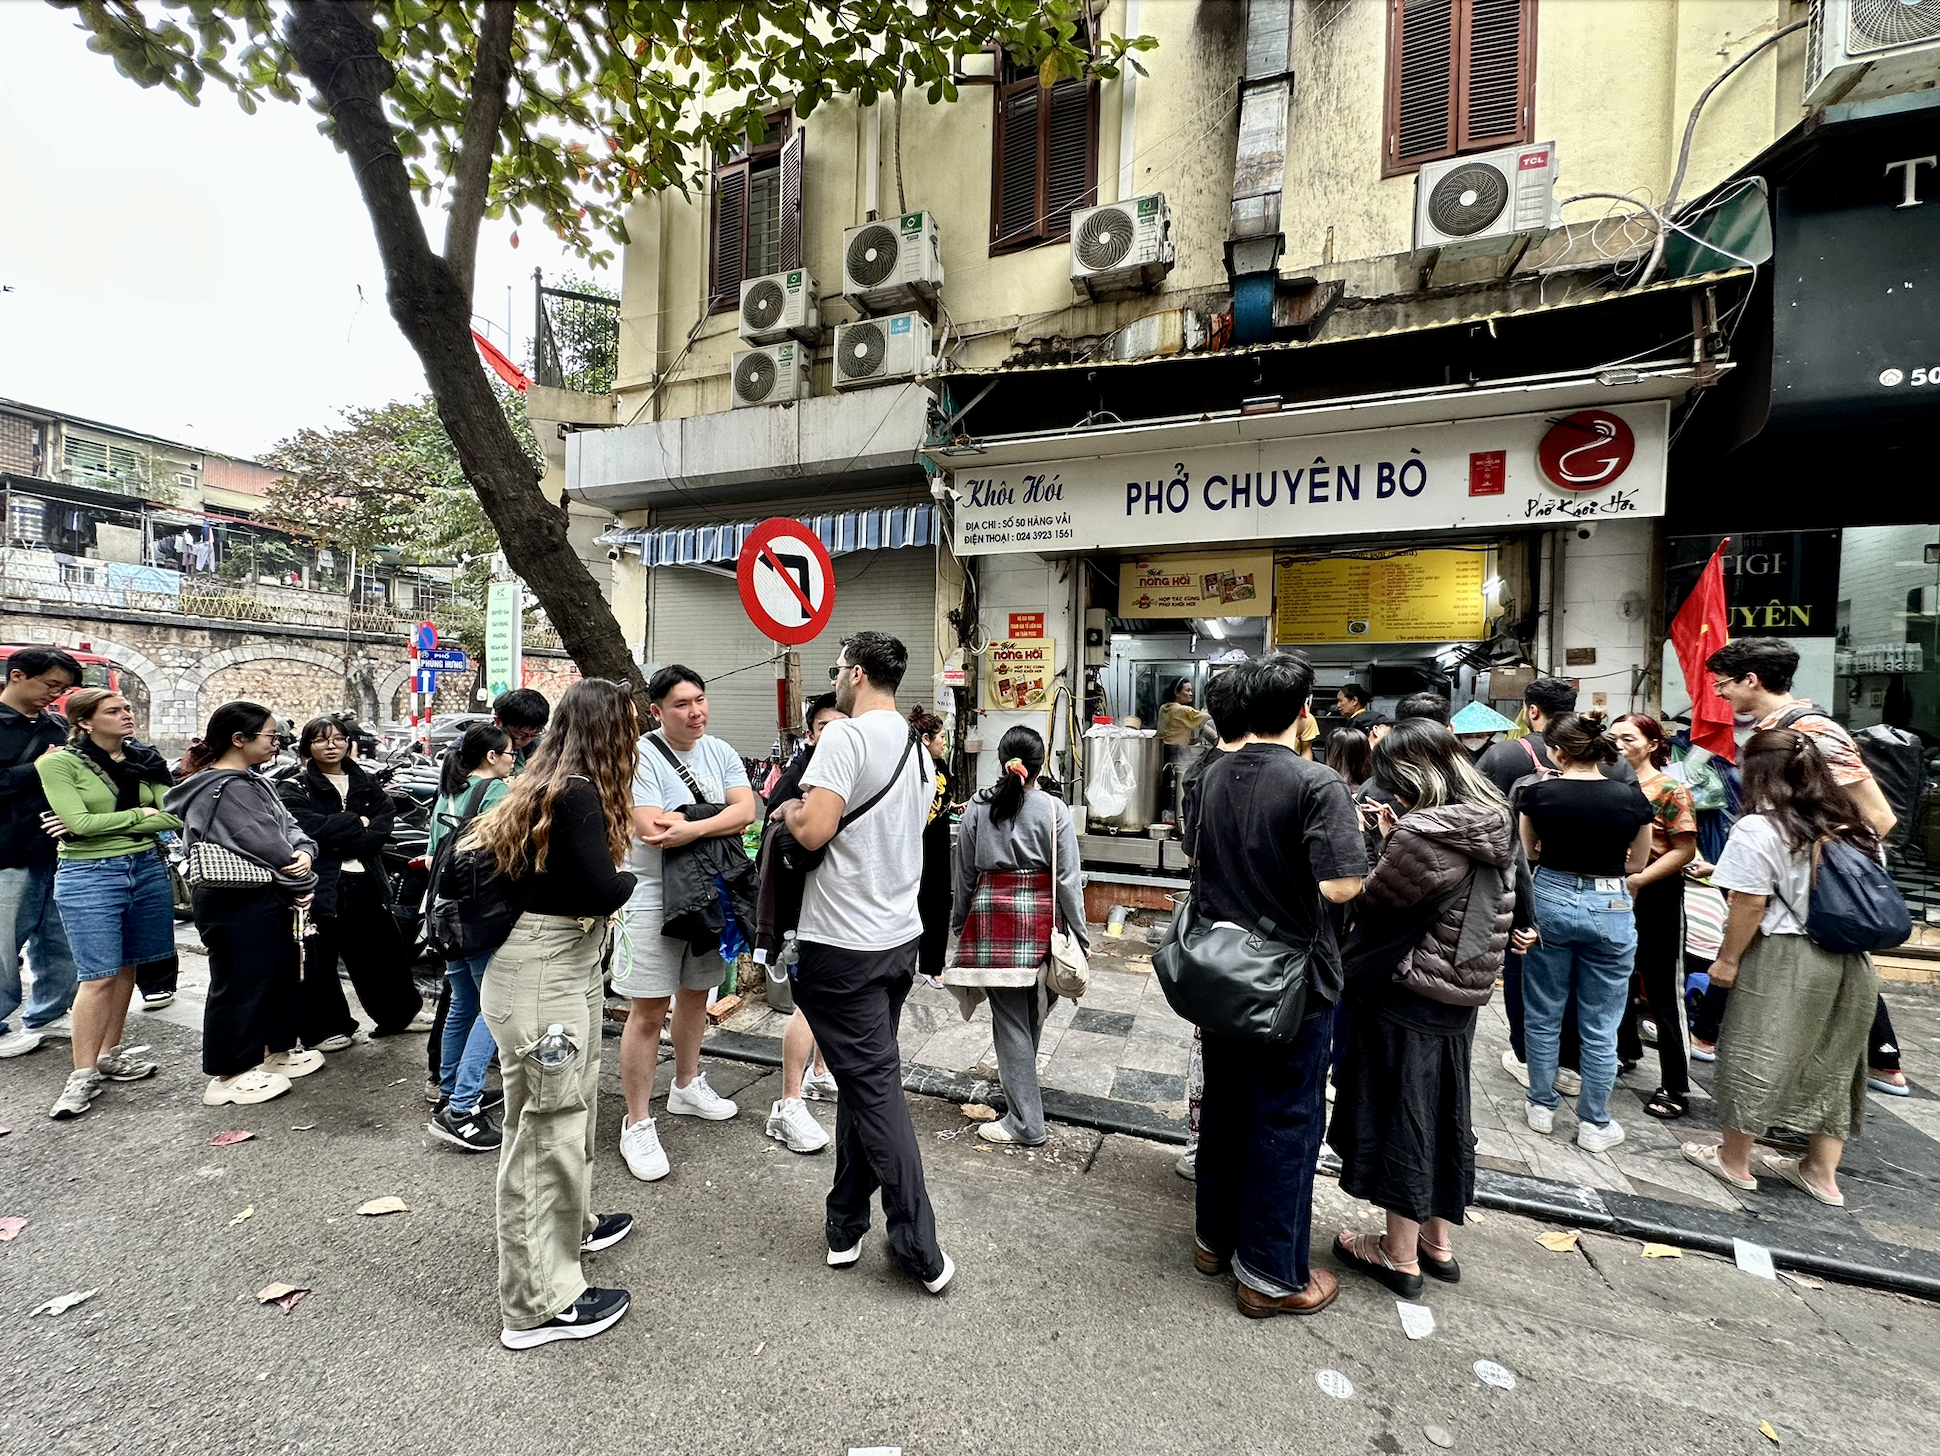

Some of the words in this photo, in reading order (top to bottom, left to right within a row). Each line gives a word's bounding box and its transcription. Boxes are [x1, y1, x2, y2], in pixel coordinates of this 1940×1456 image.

[1523, 156, 1545, 165] TCL
[1126, 462, 1190, 516] PHỞ
[1203, 456, 1361, 511] CHUYÊN
[1376, 447, 1427, 499] BÒ
[1016, 518, 1026, 528] 50
[1027, 515, 1054, 527] HÀNG
[1055, 511, 1072, 525] VẢI
[964, 533, 984, 546] ĐIỆN
[985, 533, 1010, 544] THOẠI
[1016, 531, 1031, 541] 024
[1032, 530, 1053, 540] 3923
[1055, 528, 1074, 539] 1561
[421, 658, 444, 668] PHÙNG
[444, 659, 464, 669] HƯNG
[457, 1122, 481, 1139] N
